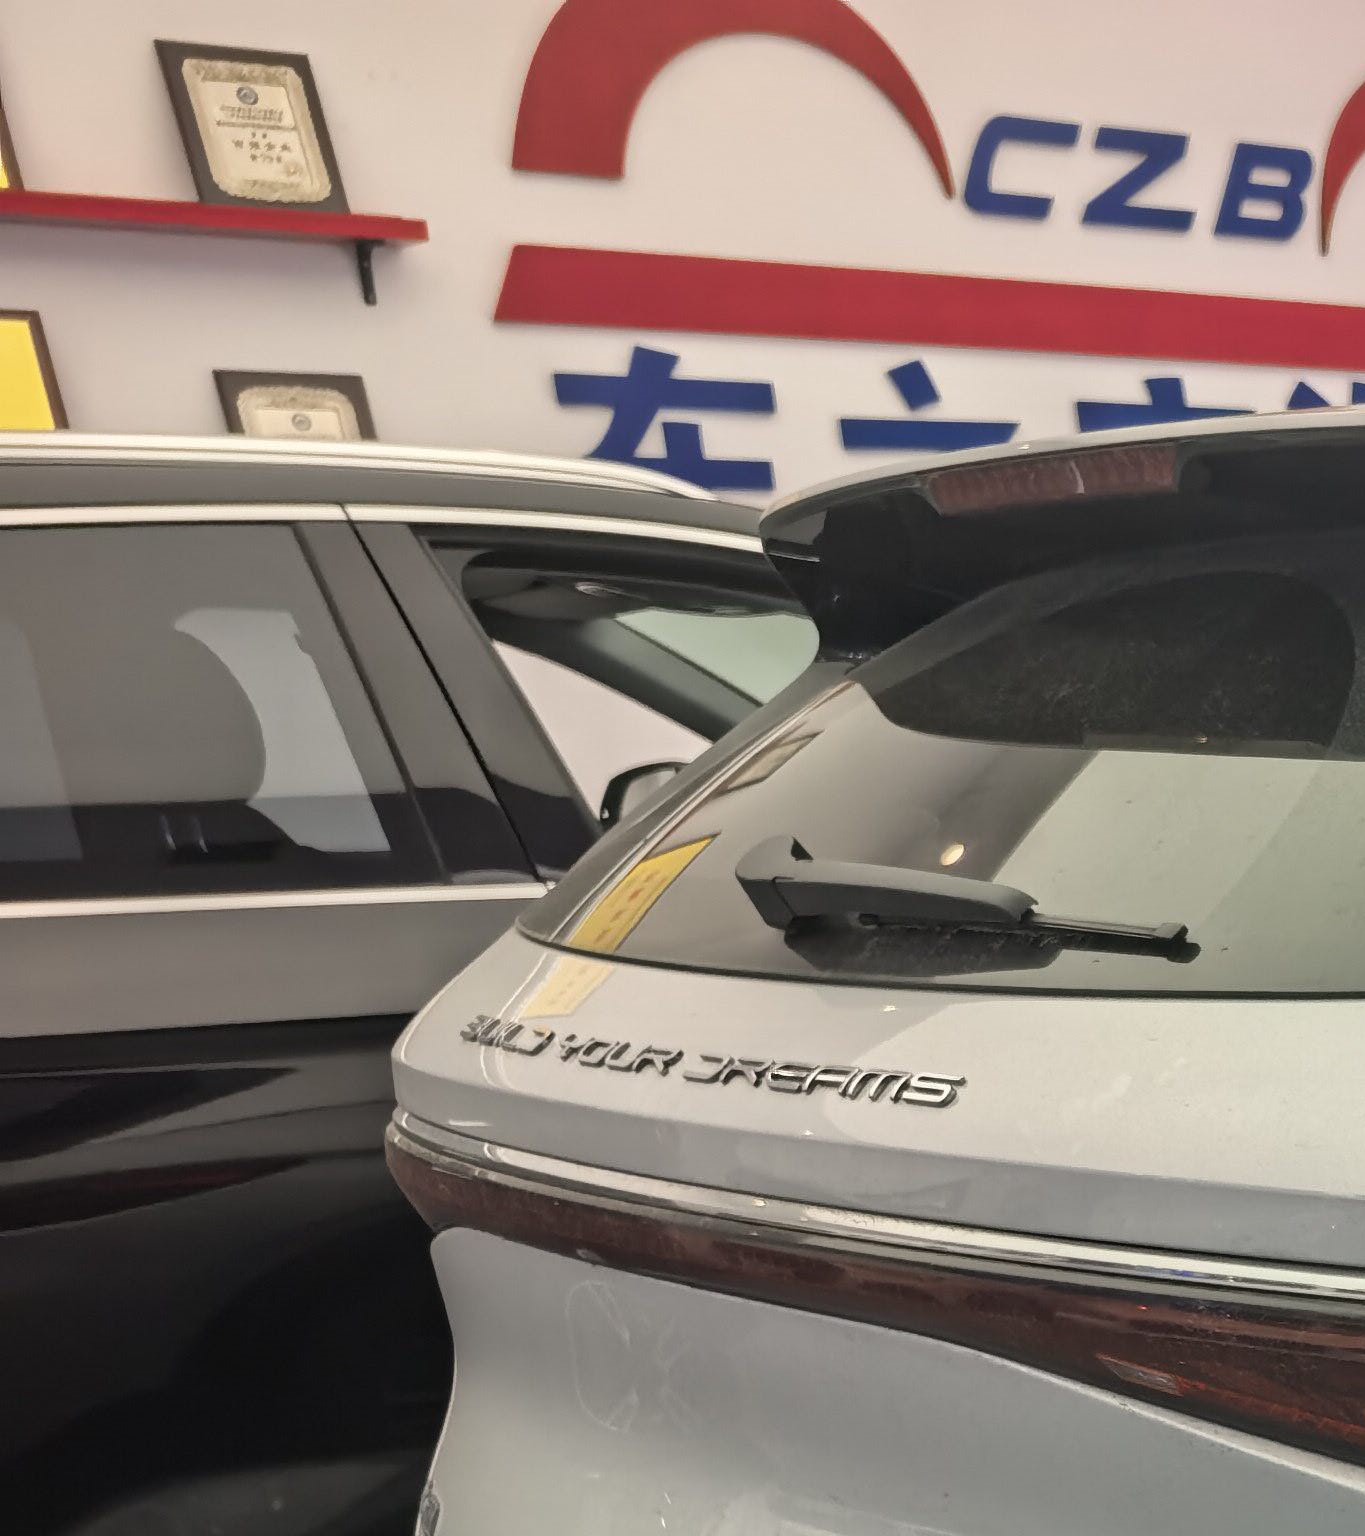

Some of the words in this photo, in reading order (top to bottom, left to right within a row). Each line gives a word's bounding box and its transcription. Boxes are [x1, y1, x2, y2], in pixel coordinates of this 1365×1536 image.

[961, 114, 1316, 242] CZB
[559, 1033, 685, 1079] YOUR
[682, 1053, 967, 1109] DREAMS
